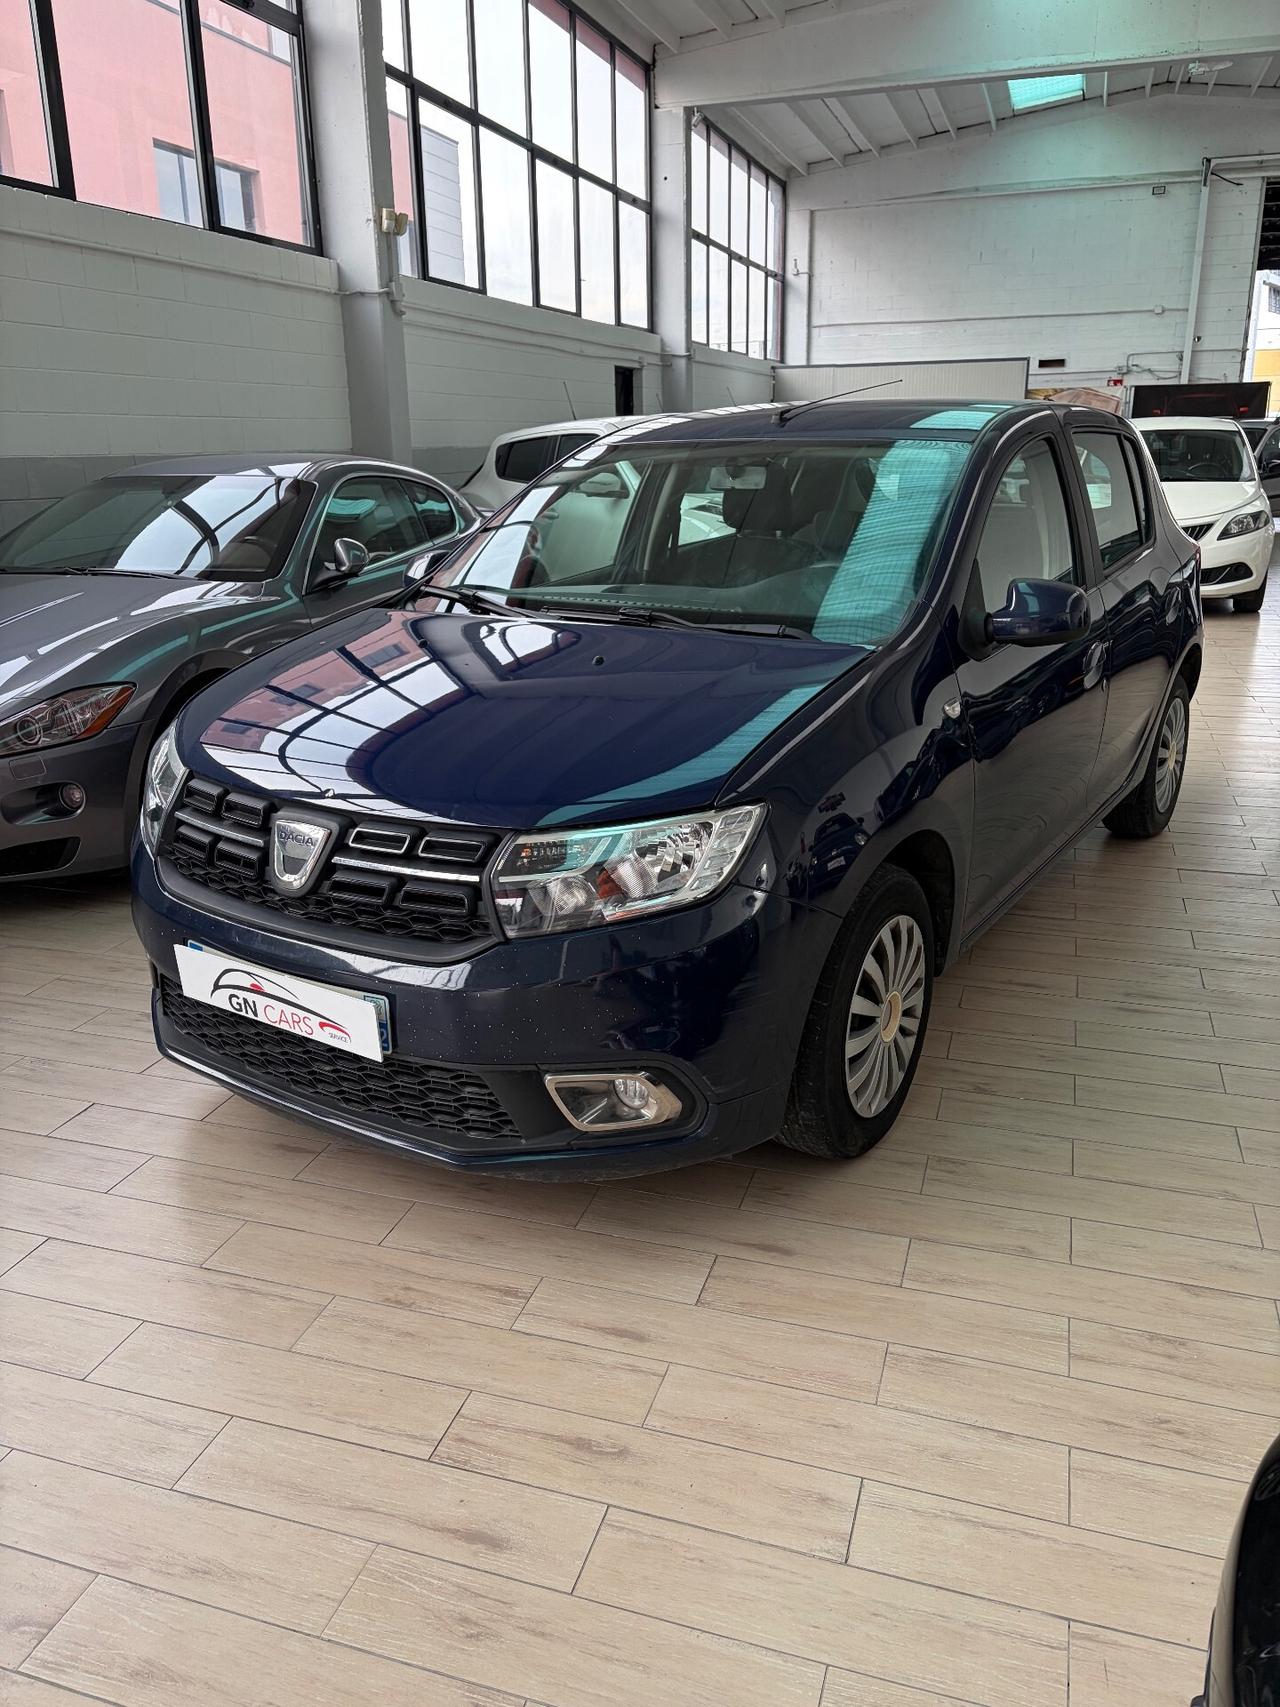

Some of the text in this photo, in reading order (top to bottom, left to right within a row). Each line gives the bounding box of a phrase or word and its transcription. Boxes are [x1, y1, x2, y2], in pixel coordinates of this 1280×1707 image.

[280, 831, 314, 846] DACIA
[228, 994, 314, 1036] GN CARS
